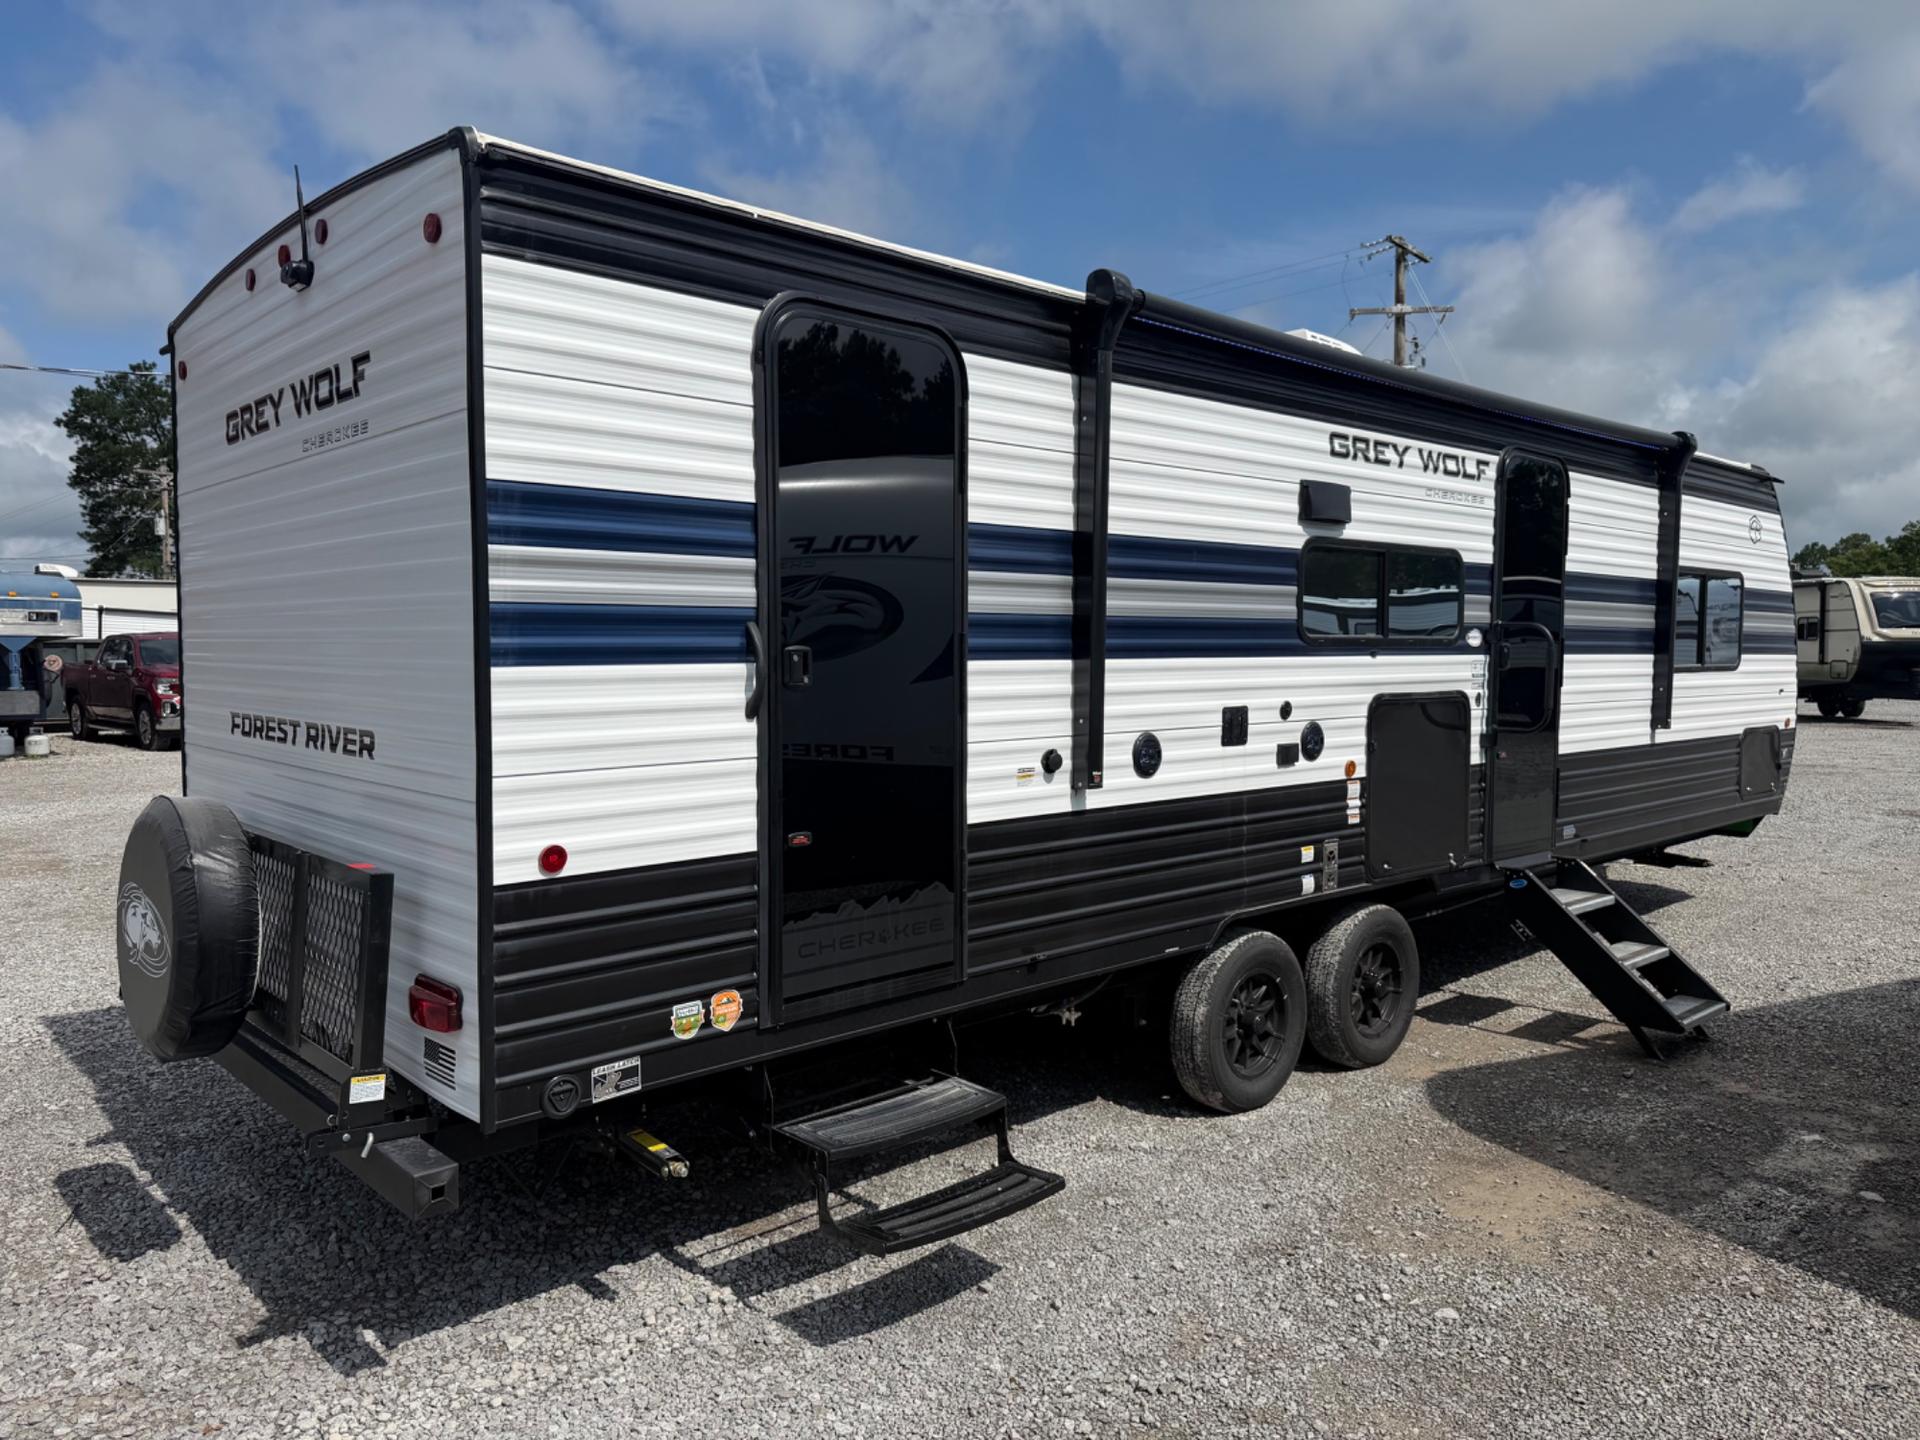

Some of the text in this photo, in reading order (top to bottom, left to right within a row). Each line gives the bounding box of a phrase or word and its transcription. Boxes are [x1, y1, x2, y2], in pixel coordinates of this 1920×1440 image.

[225, 350, 372, 446] GREY WOLF
[1328, 431, 1490, 482] GREY WOLF
[230, 711, 376, 761] FOREST RIVER
